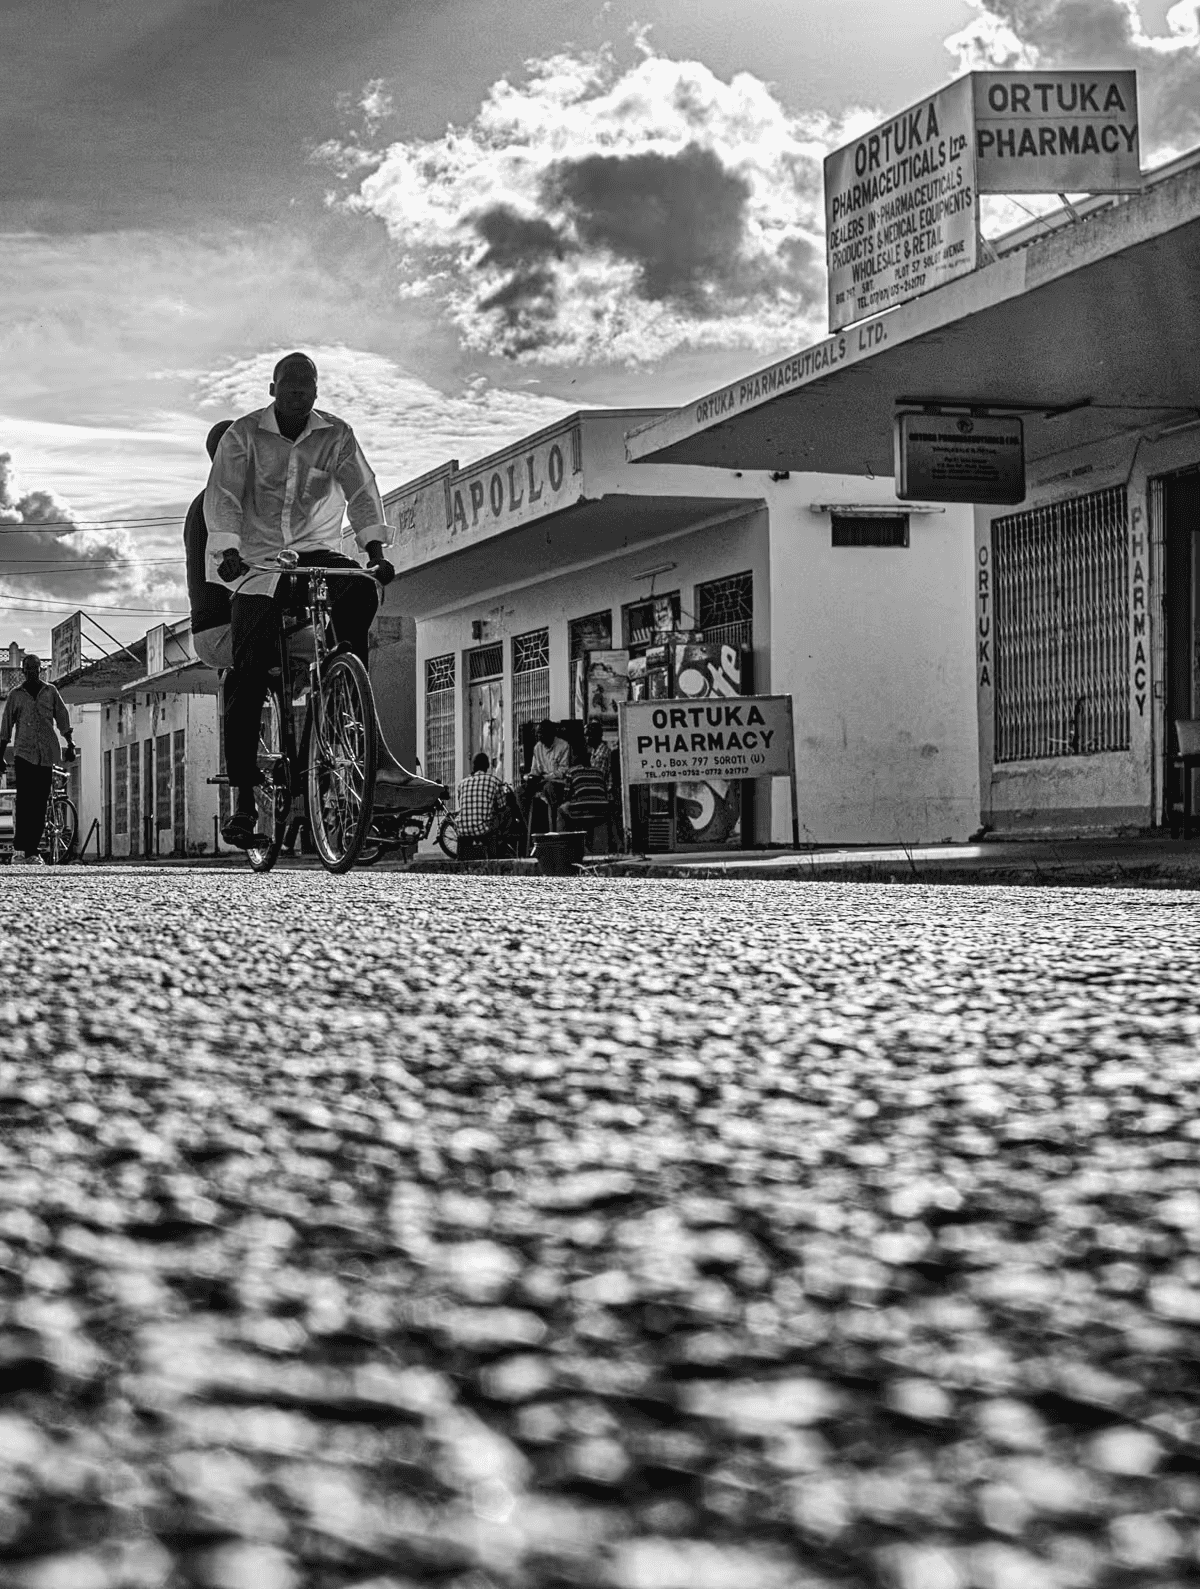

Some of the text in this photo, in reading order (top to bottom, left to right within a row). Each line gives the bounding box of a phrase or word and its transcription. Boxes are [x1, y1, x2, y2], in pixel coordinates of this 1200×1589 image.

[988, 83, 1126, 113] ORTUKA
[855, 102, 939, 177] ORTUKA
[977, 124, 1138, 159] PHARMACY
[832, 141, 946, 222] PHARMACEUTICALS
[830, 216, 864, 250] DEALERS
[833, 235, 873, 271] PRODUCTS
[884, 213, 917, 246] MEDICAL
[920, 186, 972, 229] EQUIPMENTS
[852, 243, 901, 283] WHOLESALE
[904, 240, 911, 259] &
[913, 225, 943, 257] RETAIL
[697, 322, 888, 424] ORTUKA PHARMACEUTICALS LTD.
[451, 444, 563, 536] APOLLO
[978, 545, 991, 687] ORTUKA
[1131, 506, 1147, 717] PHARMACY
[637, 730, 774, 754] PHARMACY
[652, 705, 766, 729] ORTUKA
[692, 757, 708, 766] 797
[714, 755, 746, 765] SOROTI
[750, 754, 766, 764] (U)
[725, 767, 749, 775] 621717
